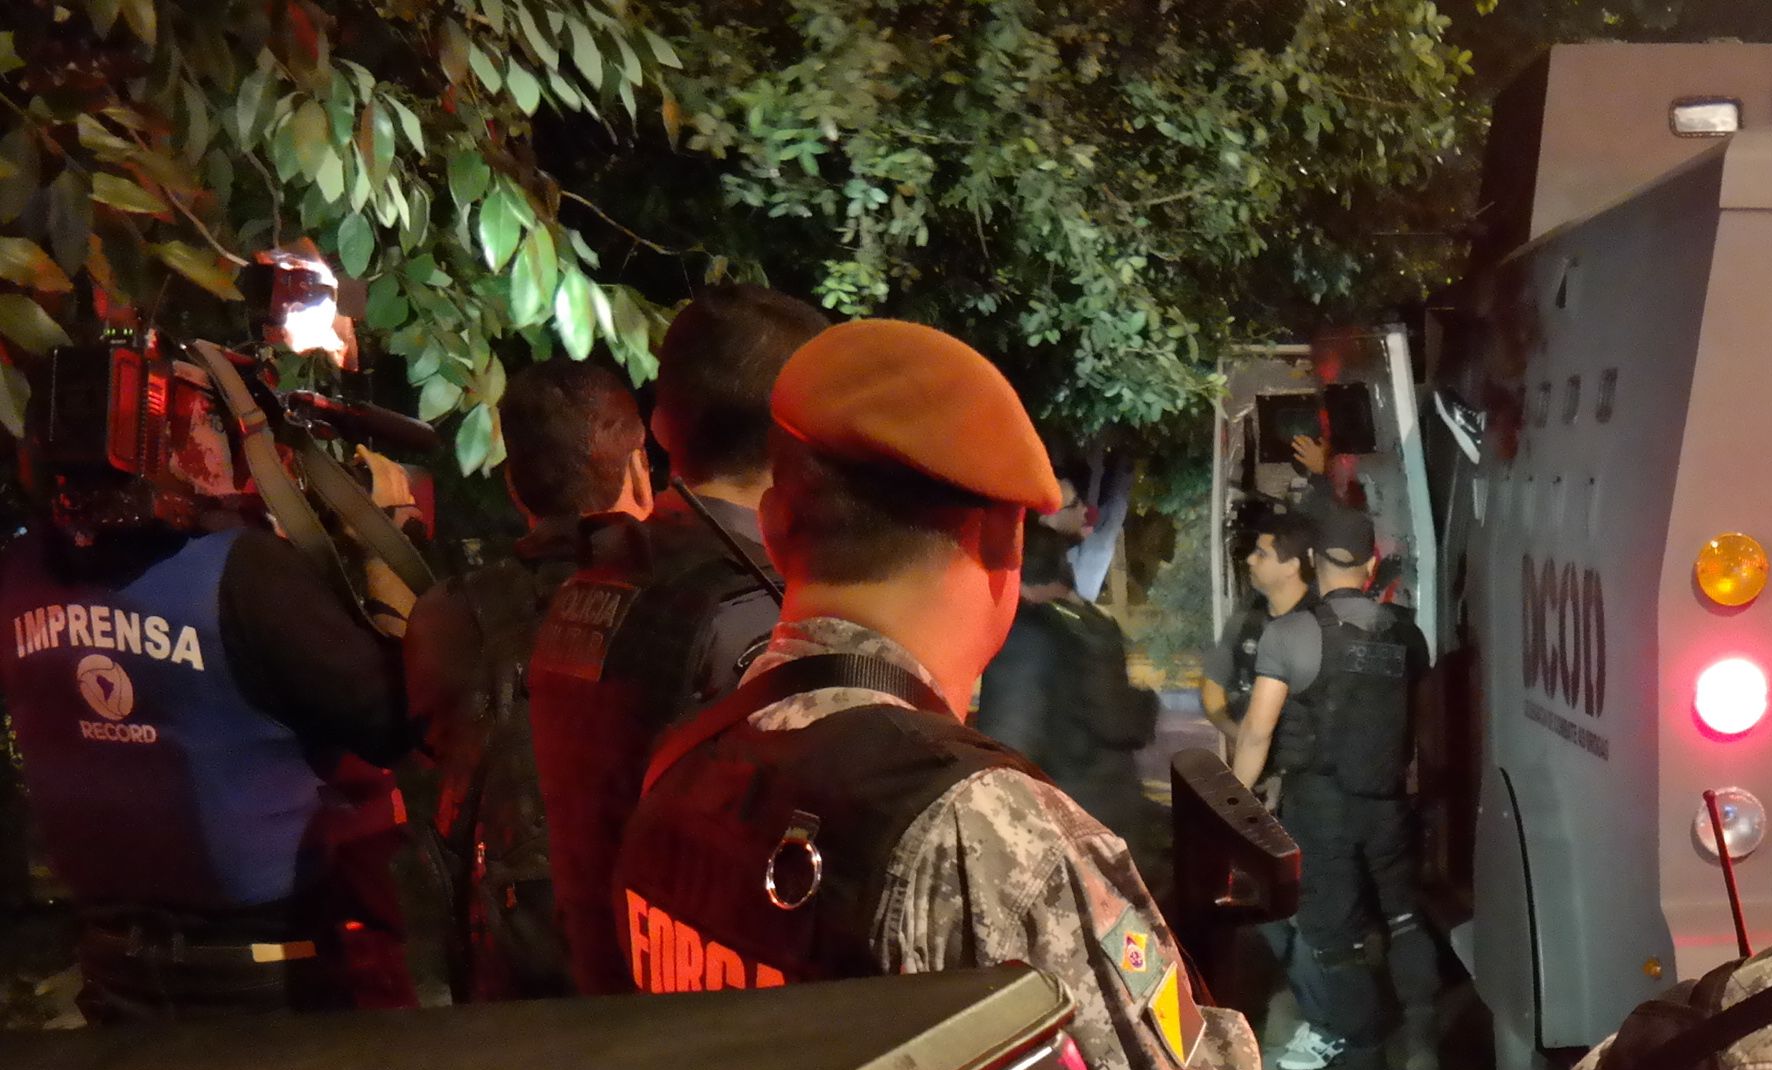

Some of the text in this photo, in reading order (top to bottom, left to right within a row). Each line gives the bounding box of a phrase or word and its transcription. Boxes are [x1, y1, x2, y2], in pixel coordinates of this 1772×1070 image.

[14, 604, 205, 671] IMPRENSA
[79, 720, 157, 743] RECORD
[625, 887, 786, 995] FOR
